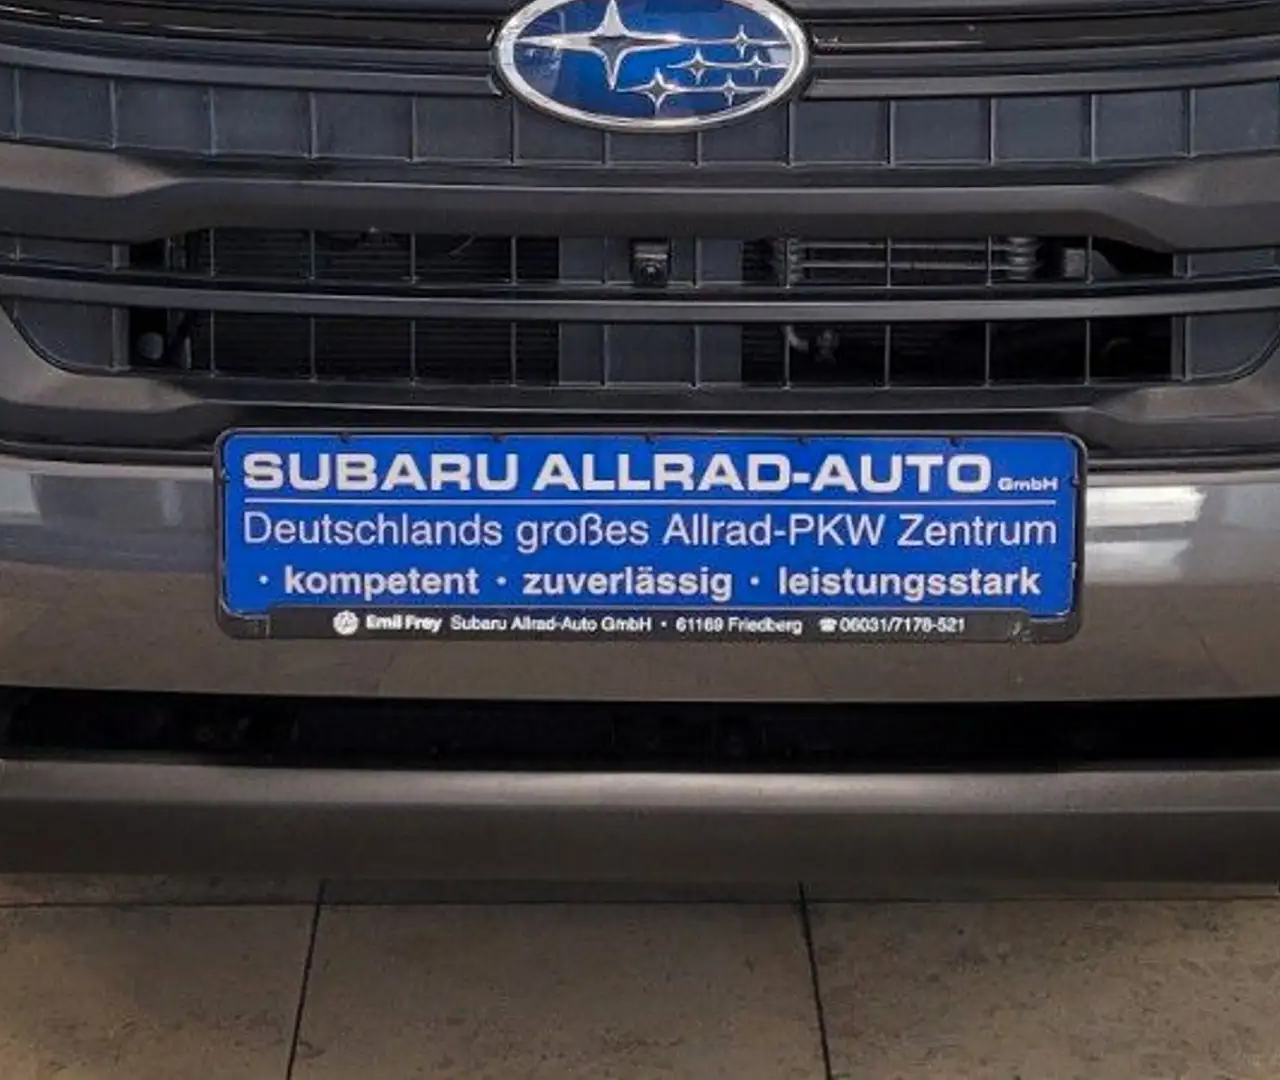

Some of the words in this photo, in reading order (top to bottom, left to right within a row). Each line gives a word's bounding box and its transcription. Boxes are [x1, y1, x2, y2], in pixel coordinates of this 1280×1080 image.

[242, 451, 520, 493] SUBARU
[532, 451, 992, 493] ALLRAD-AUTO
[996, 476, 1058, 492] GmbH
[243, 510, 503, 547] Deutschlands
[517, 512, 651, 555] großes
[663, 512, 887, 547] Allrad-PKW
[897, 513, 1058, 548] Zentrum
[284, 564, 481, 601] kompetent
[522, 564, 733, 602] zuverlässig
[777, 565, 1042, 602] leistungsstark
[365, 614, 403, 631] Emil
[405, 615, 443, 634] Frey
[450, 615, 507, 631] Subaru
[510, 616, 598, 632] Allrad-Auto
[600, 616, 652, 632] GmbH
[675, 616, 723, 633] 61169
[727, 616, 803, 635] Friedberg
